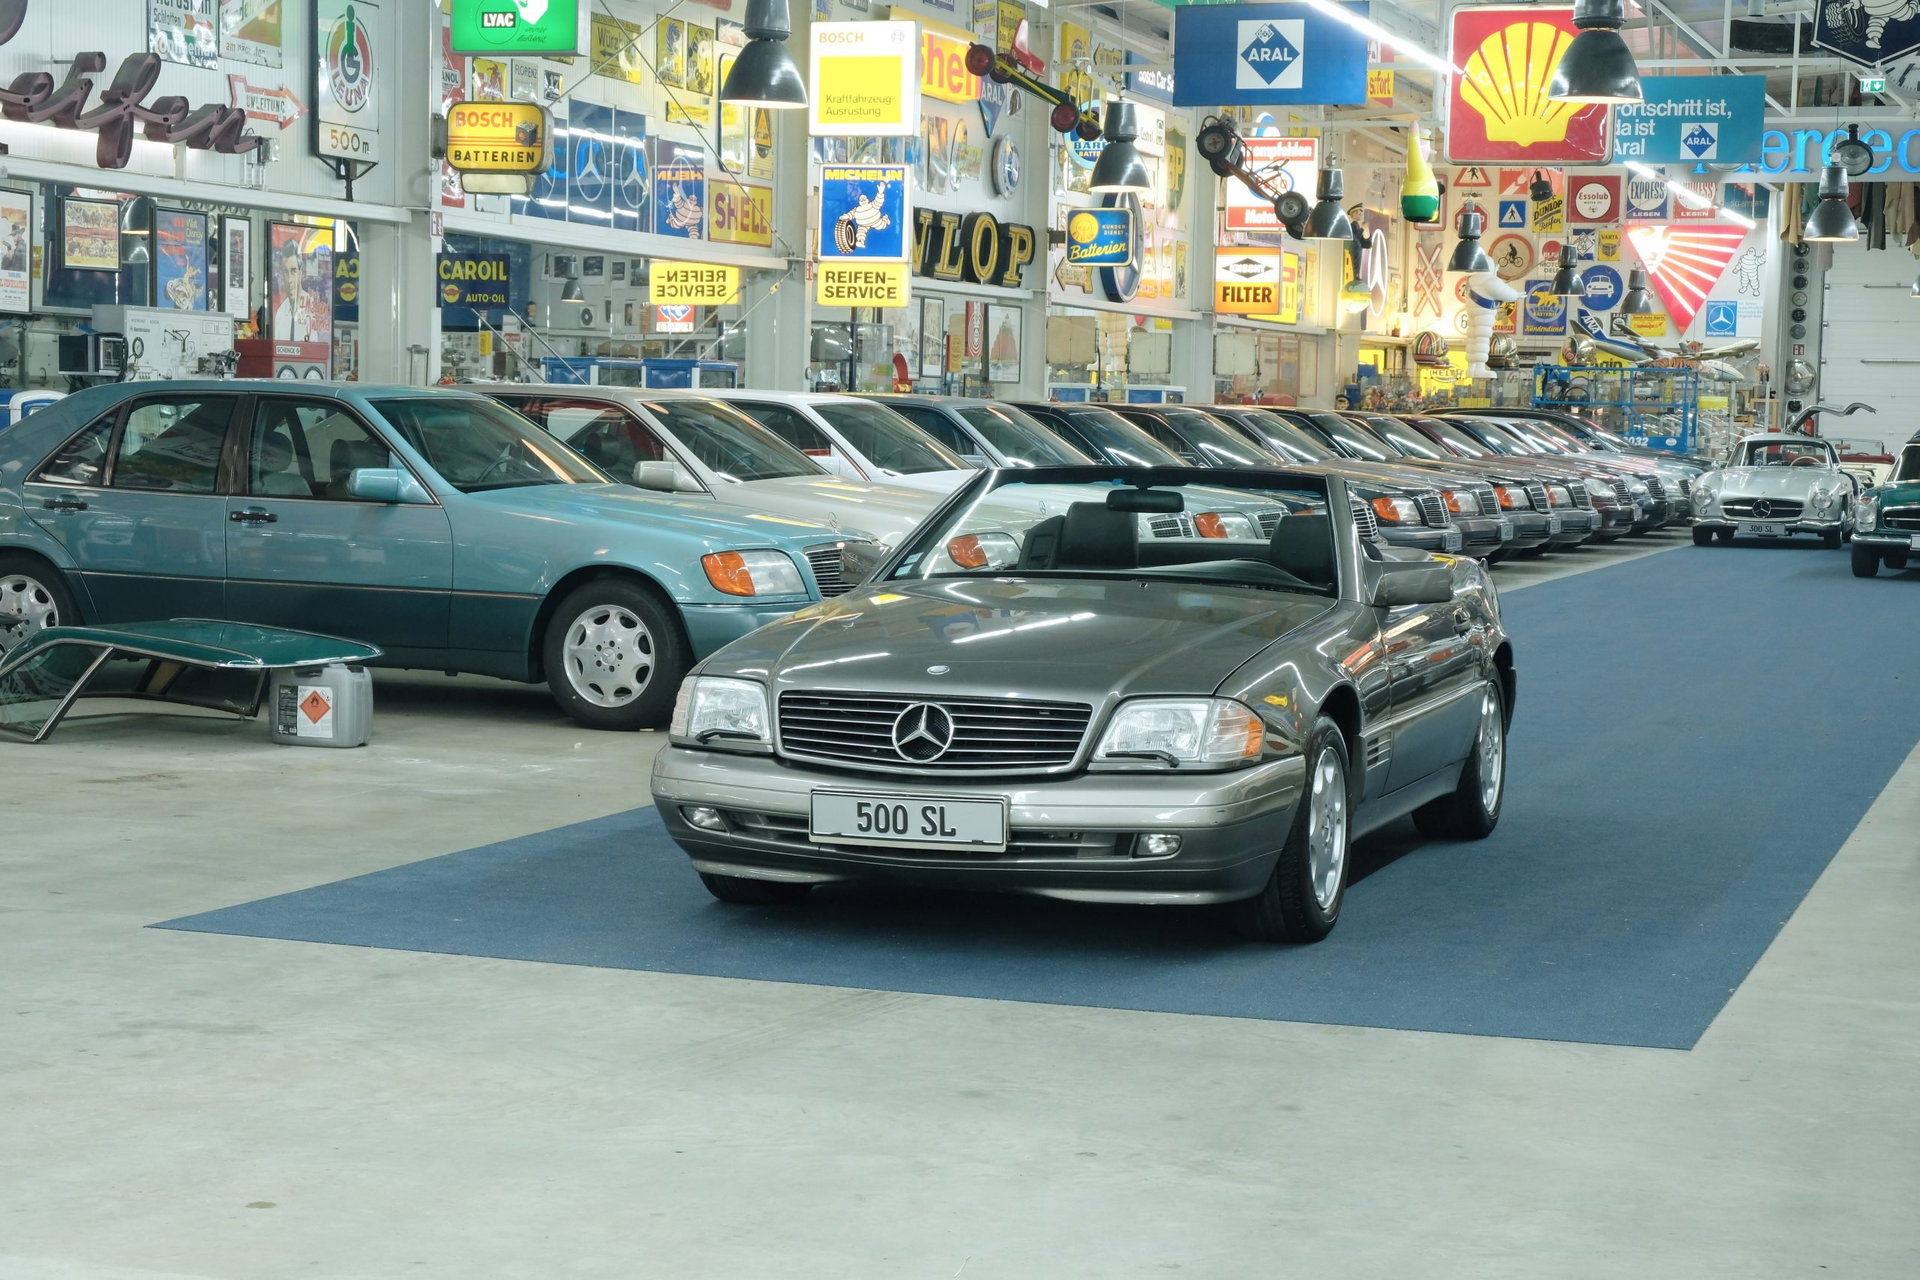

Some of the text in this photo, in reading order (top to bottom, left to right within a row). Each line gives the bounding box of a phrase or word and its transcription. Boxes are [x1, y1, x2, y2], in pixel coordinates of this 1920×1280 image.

[483, 13, 515, 27] LYAC
[819, 32, 864, 44] BOSCH
[1248, 47, 1293, 62] ARAL
[1705, 99, 1732, 119] ist,
[455, 111, 513, 128] BOSCH
[1634, 119, 1656, 136] ist
[330, 129, 360, 152] 500
[1686, 137, 1712, 146] ARAL
[454, 150, 535, 163] BATTERIEN
[824, 169, 903, 181] MICHELIN
[1578, 191, 1609, 201] Essolub
[1630, 181, 1665, 200] EXPRESS
[714, 192, 768, 235] SHELL
[1533, 199, 1563, 221] DUNLOP
[913, 206, 1036, 288] NLOP
[1070, 240, 1127, 261] Batterien
[439, 259, 507, 281] CAROIL
[465, 293, 506, 303] AUTO-OIL
[824, 285, 897, 299] SERVICE
[1222, 286, 1273, 303] FILTER
[1749, 524, 1774, 533] 300 SL
[857, 801, 956, 837] 500 SL
